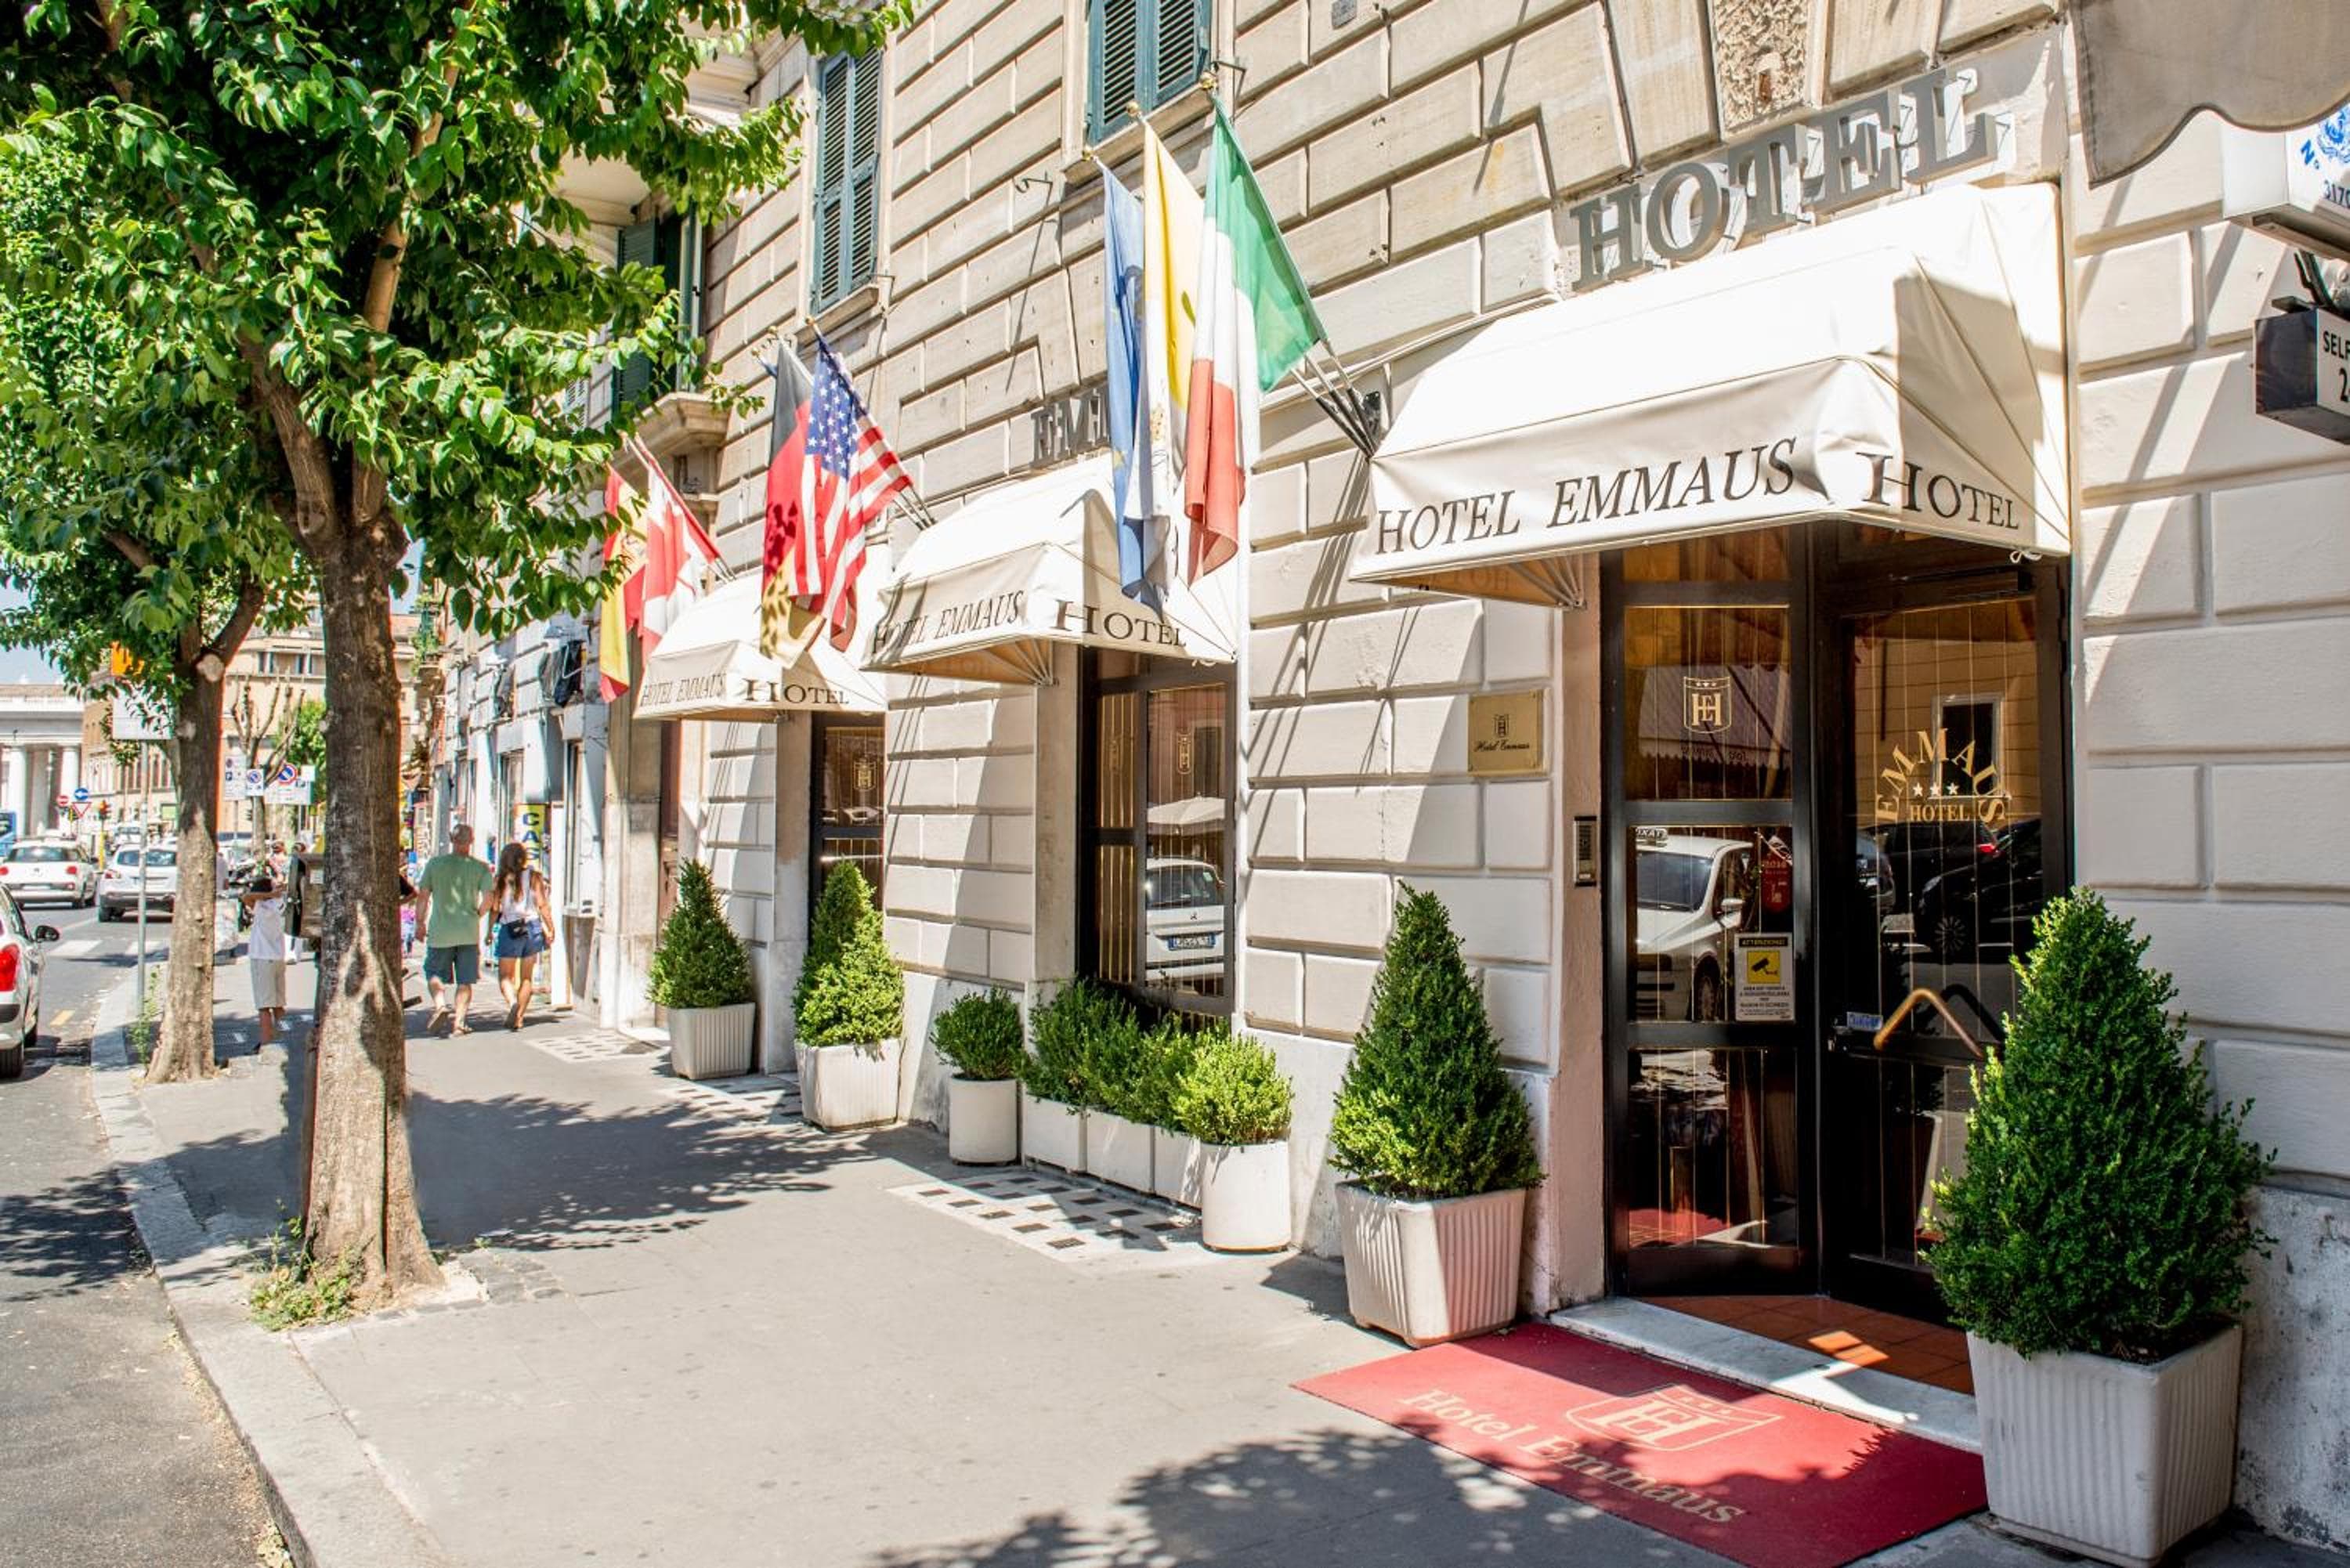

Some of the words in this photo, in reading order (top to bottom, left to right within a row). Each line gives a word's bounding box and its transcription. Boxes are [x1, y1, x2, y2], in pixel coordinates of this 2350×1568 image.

[1569, 68, 1998, 293] HOTEL
[1376, 490, 1520, 555] HOTEL
[1546, 435, 1799, 529] EMMAUS
[1855, 451, 2019, 530] HOTEL
[934, 590, 1024, 640] EMMAUS
[1049, 599, 1187, 647] HOTEL
[742, 677, 850, 704] HOTEL
[1875, 728, 2006, 824] EMMAUS
[1910, 804, 1970, 822] HOTEL
[1394, 1389, 1538, 1441] Hotel
[1517, 1435, 1745, 1523] Emmaus
